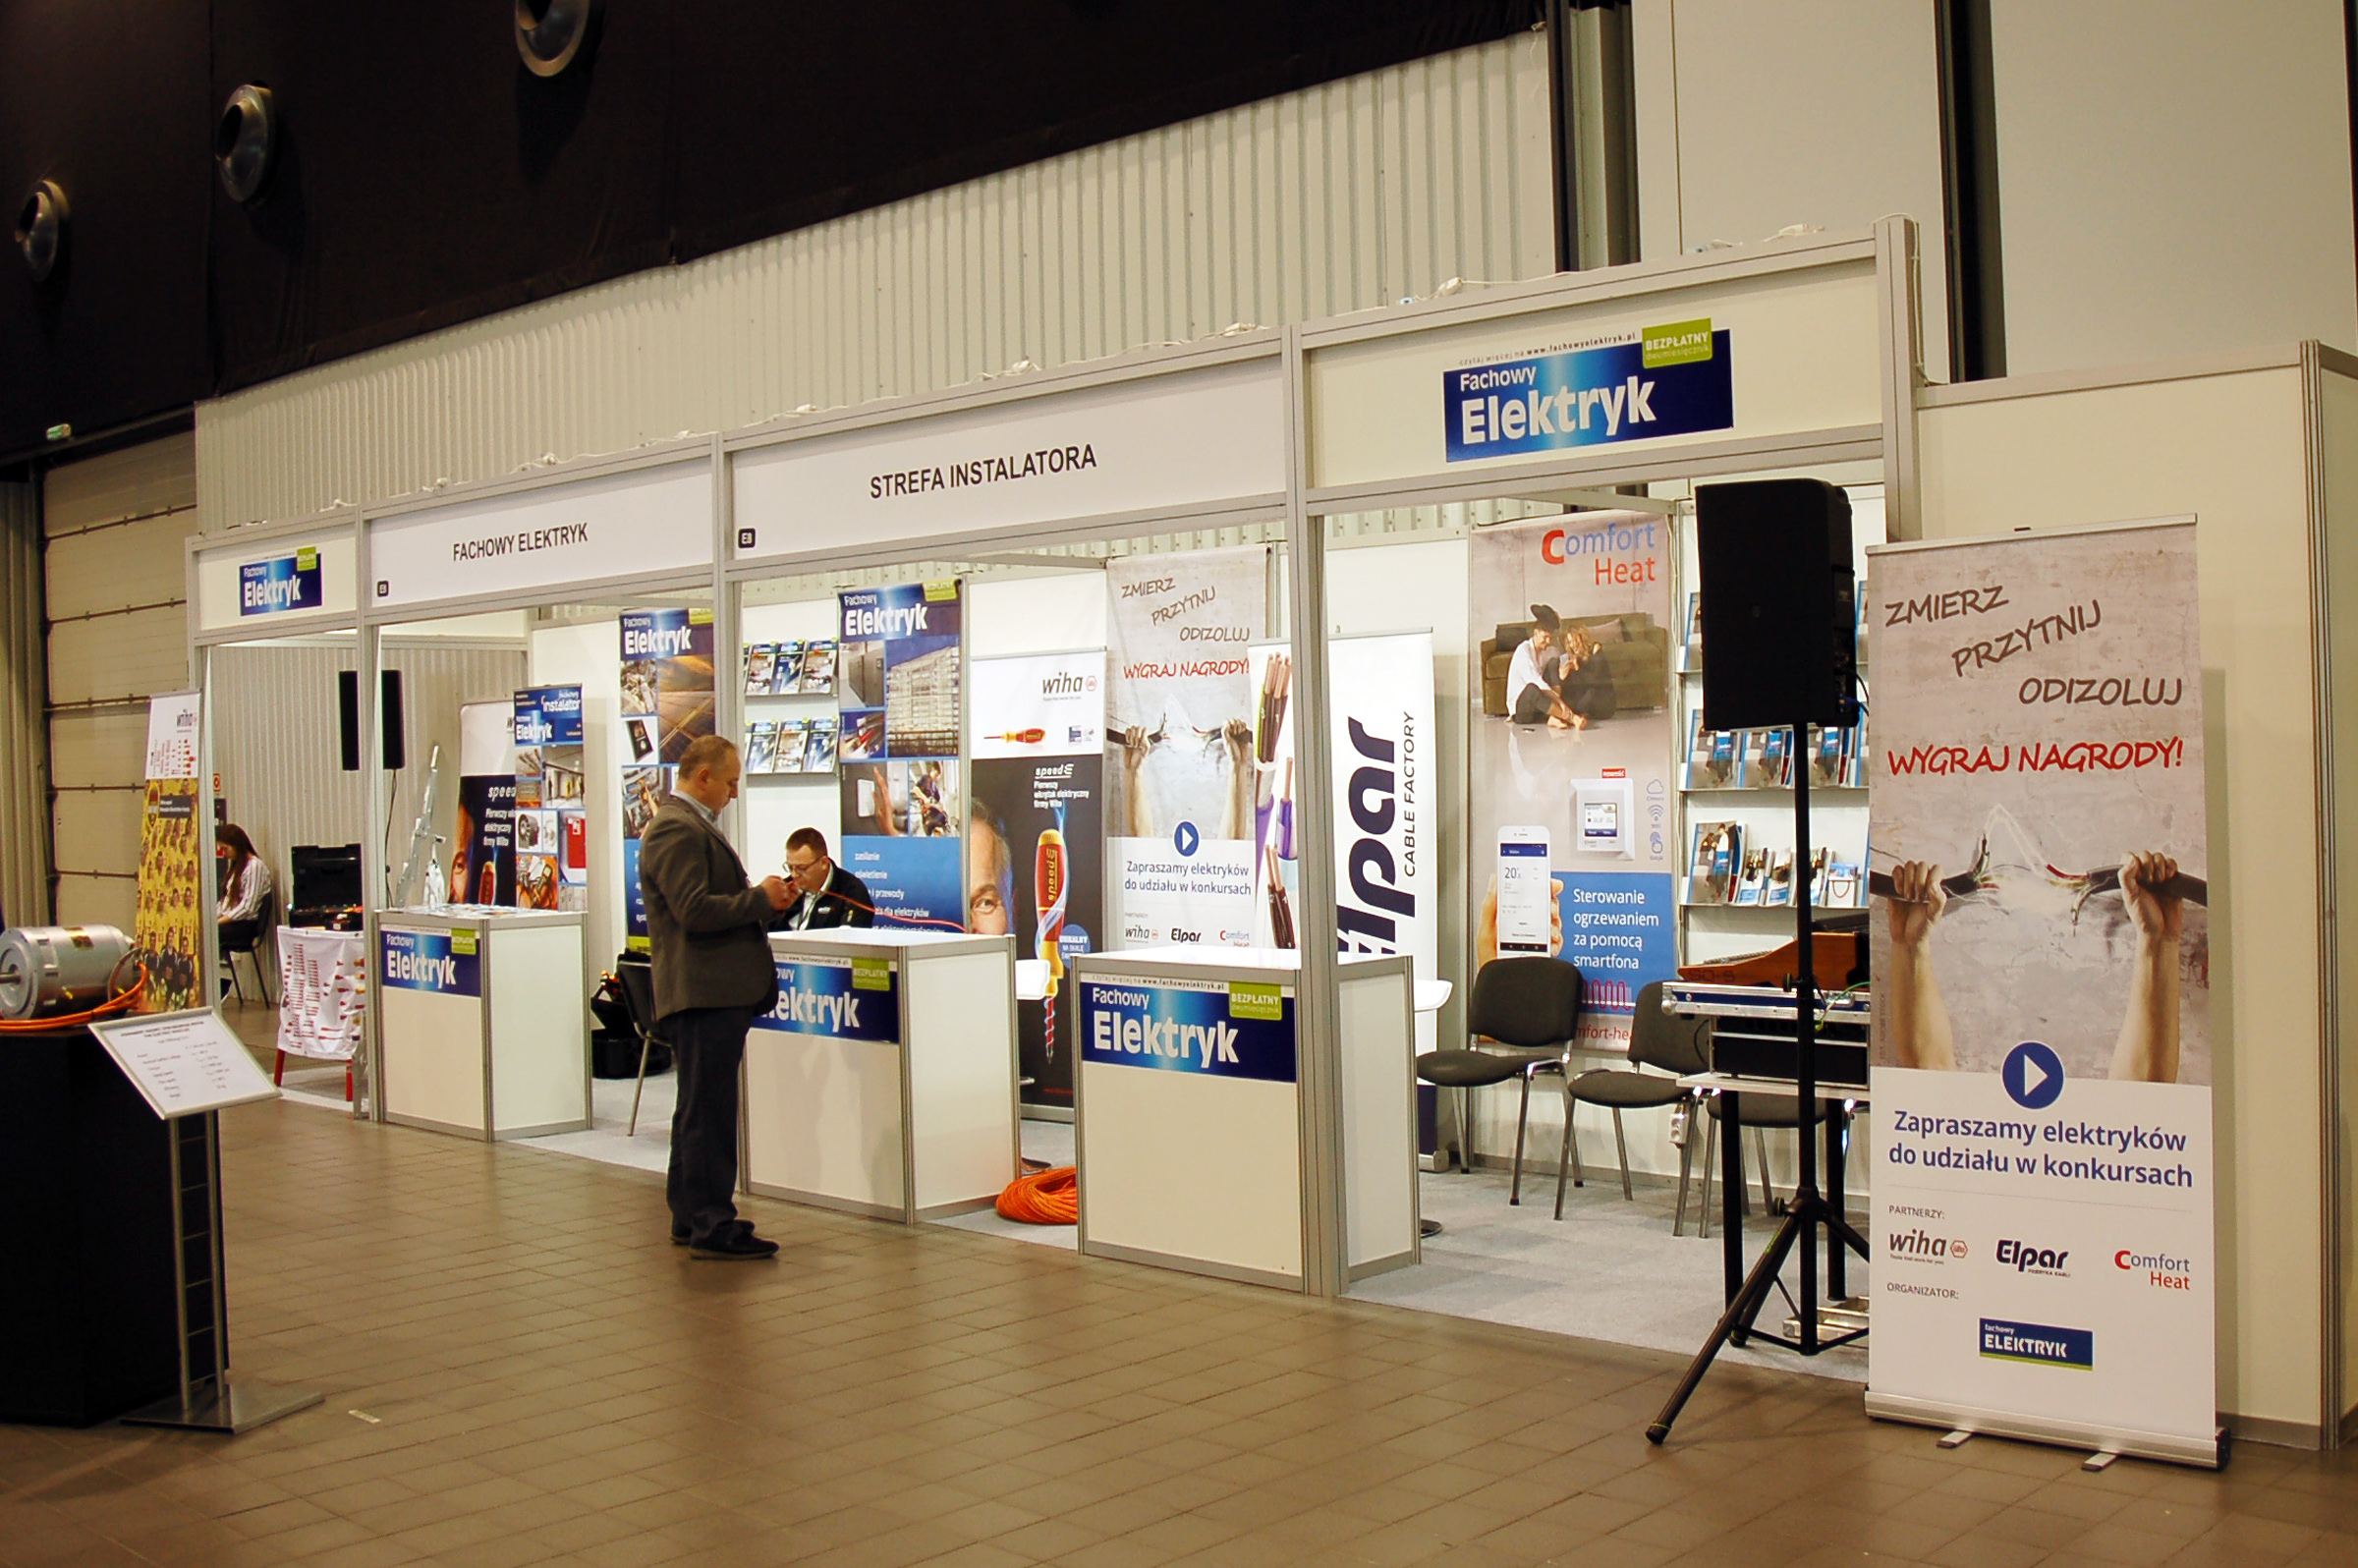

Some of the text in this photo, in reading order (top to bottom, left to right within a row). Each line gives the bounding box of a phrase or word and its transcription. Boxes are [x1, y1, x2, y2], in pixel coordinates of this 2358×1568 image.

[1646, 332, 1709, 351] BEZPŁATNY
[1459, 365, 1537, 392] Fachowy
[1462, 375, 1656, 445] Elektryk
[870, 444, 1097, 499] STREFA INSTALATORA
[453, 522, 589, 561] FACHOWY ELEKTRYK
[1542, 522, 1656, 565] Comfort
[1595, 557, 1656, 586] Heat
[244, 575, 302, 607] Elektryk
[843, 592, 877, 607] Fachowy
[1121, 577, 1177, 598] ZMIERZ
[844, 603, 928, 637] Elektryk
[1151, 586, 1216, 627] PRZYTNIJ
[1884, 585, 2010, 628] ZMIERZ
[625, 625, 692, 655] Elektryk
[1179, 627, 1251, 643] ODIZOLUJ
[1951, 599, 2103, 678] PRZYTNIJ
[1042, 672, 1083, 694] wiha
[1123, 662, 1177, 680] WYGRAJ
[2018, 677, 2183, 706] ODIZOLUJ
[1887, 736, 2184, 776] WYGRAJ NAGRODY!
[1402, 710, 1416, 877] CABLE FACTORY
[1336, 715, 1416, 954] lpar
[1126, 861, 1250, 878] Zapraszamy elektryków
[1124, 878, 1252, 895] do udziału w konkursach
[1573, 888, 1646, 905] Sterowanie
[1125, 924, 1151, 939] wiha
[1573, 912, 1659, 928] ogrzewaniem
[386, 933, 414, 949] Fachowy
[1170, 927, 1203, 943] Elpar
[1573, 934, 1643, 951] za pomocą
[387, 949, 457, 989] Elektryk
[1573, 953, 1640, 970] smartfona
[760, 986, 861, 1033] ektryk
[1093, 986, 1151, 1010] Fachowy
[1231, 992, 1279, 1006] BEZPŁATNY
[1094, 1009, 1240, 1069] Elektryk
[1893, 1110, 2187, 1154] Zapraszamy elektryków
[1888, 1143, 2194, 1188] do udziału w konkursach
[1888, 1204, 1945, 1219] PARTNERZY:
[1889, 1228, 1947, 1257] wiha
[1995, 1239, 2069, 1272] Elpar
[2114, 1250, 2190, 1272] Comfort
[1886, 1282, 1959, 1300] ORGANIZATOR:
[2150, 1270, 2190, 1291] Heat
[1985, 1333, 2067, 1358] ELEKTRYK
